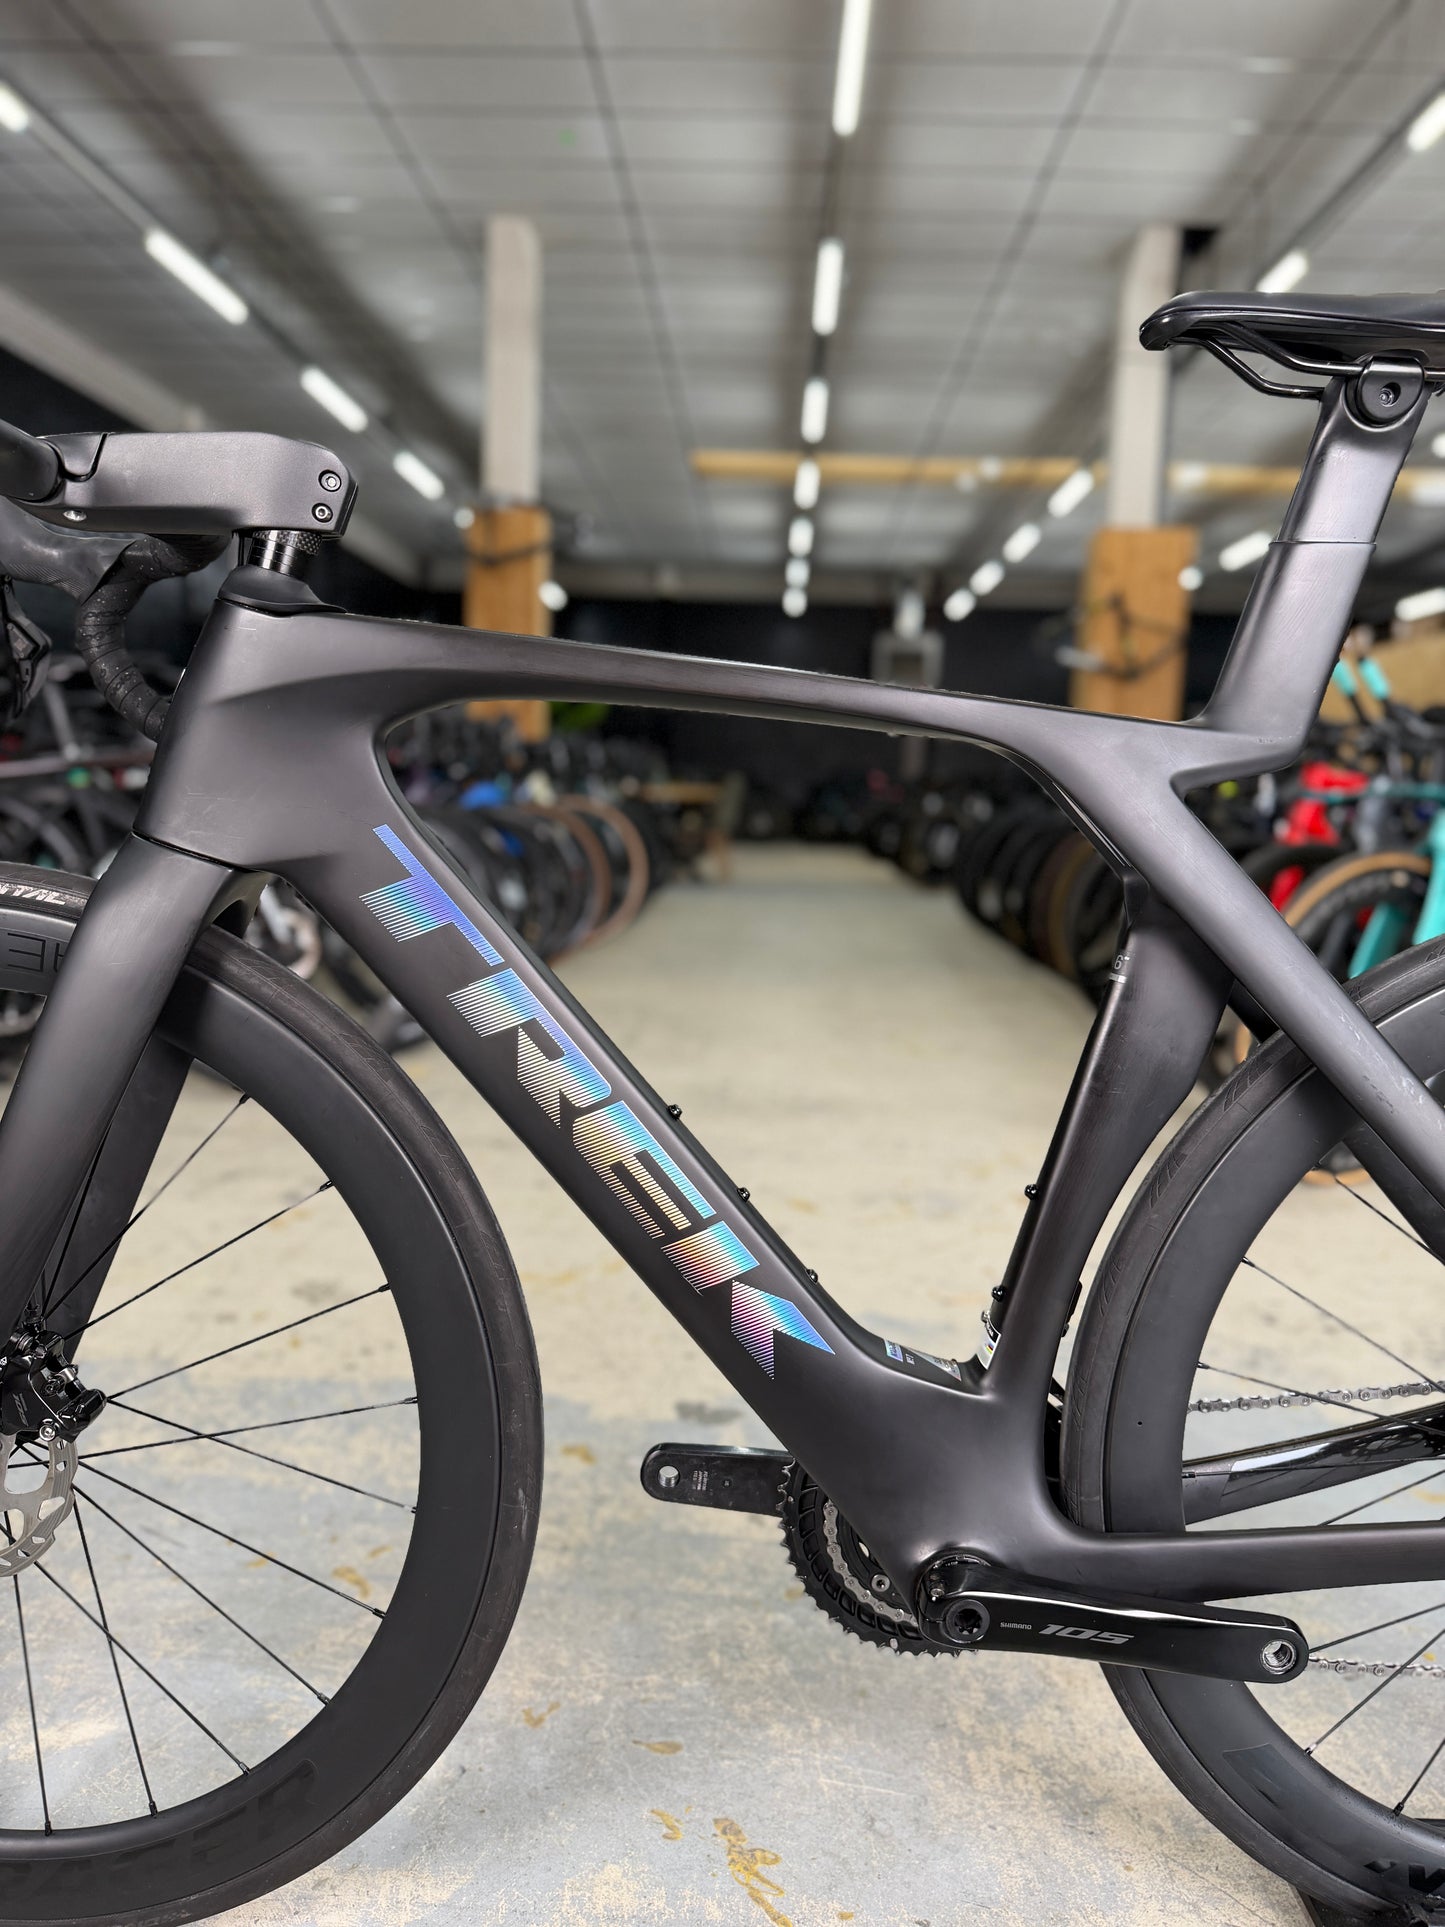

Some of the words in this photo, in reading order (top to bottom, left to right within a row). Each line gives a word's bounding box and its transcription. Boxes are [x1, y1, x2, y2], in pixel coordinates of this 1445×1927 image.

[358, 823, 836, 1380] TREK
[1000, 1621, 1032, 1630] SHIMANO
[1039, 1623, 1135, 1645] 105
